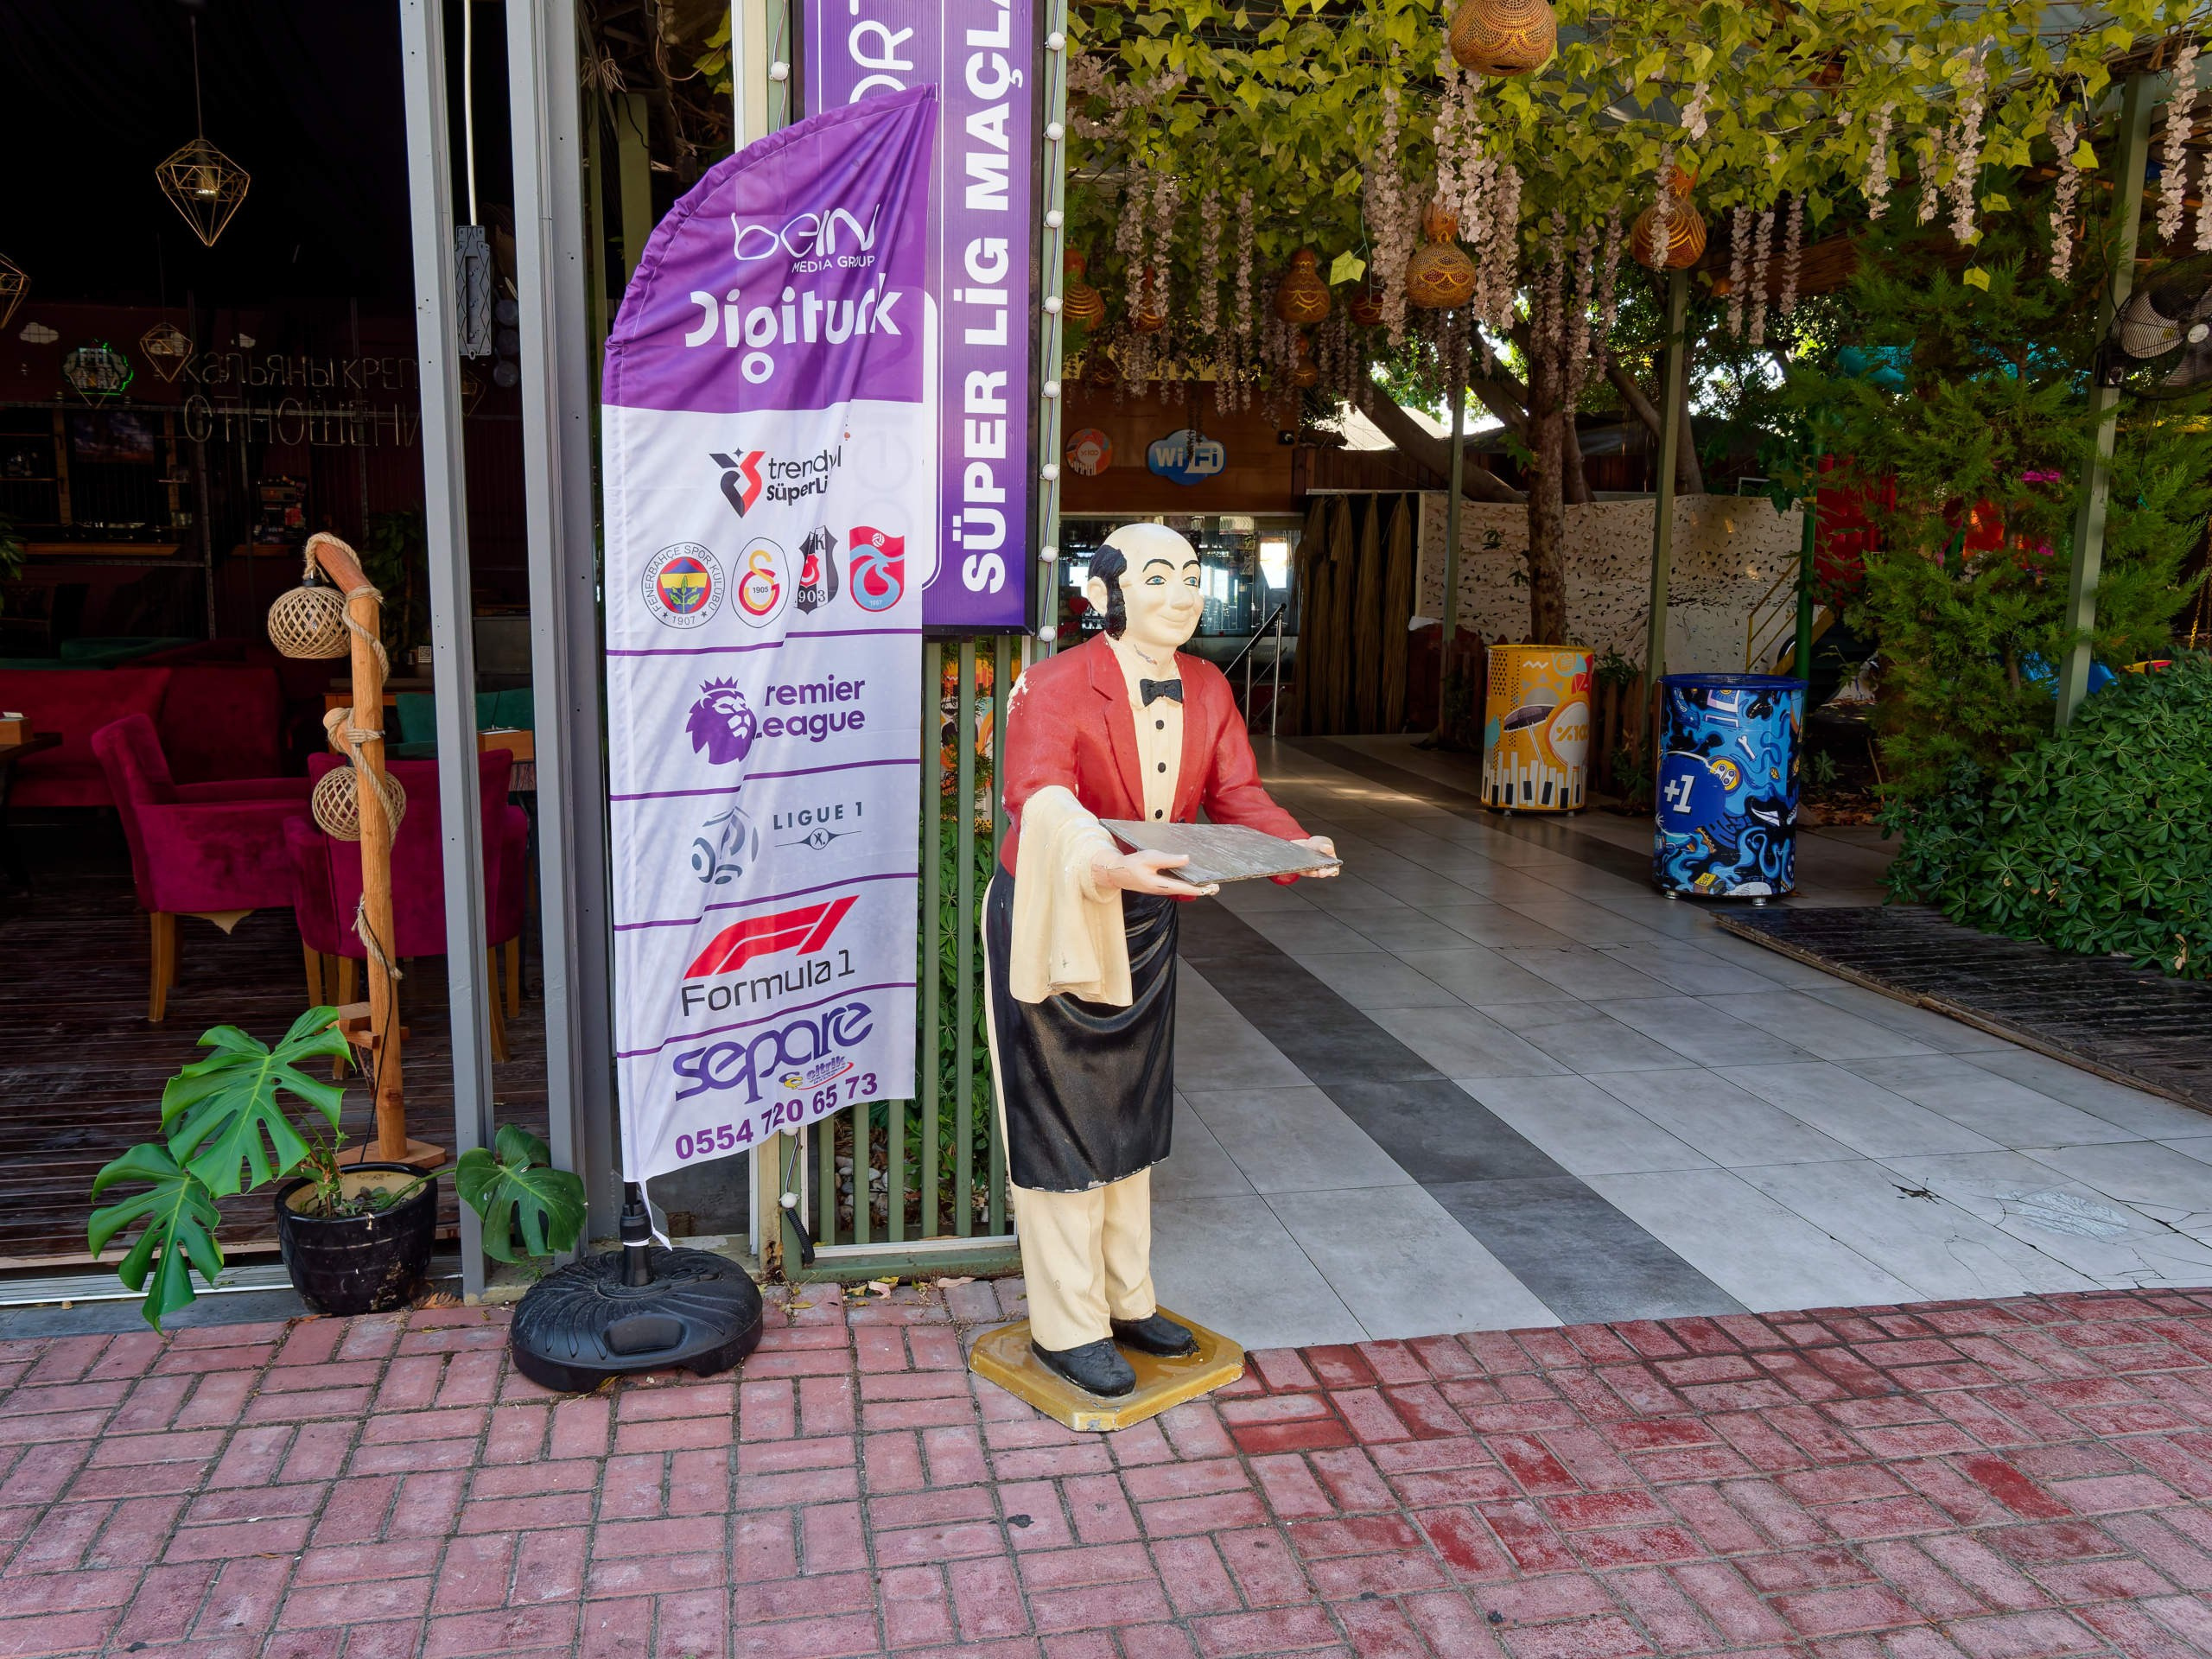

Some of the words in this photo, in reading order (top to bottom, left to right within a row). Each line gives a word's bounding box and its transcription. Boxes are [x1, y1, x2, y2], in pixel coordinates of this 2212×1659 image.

[964, 0, 1024, 211] MAÇL
[791, 258, 833, 273] MEDIA
[837, 255, 875, 268] GROUP
[685, 273, 902, 384] Digiturk
[766, 475, 828, 506] SüperLi
[952, 370, 1008, 594] SÜPER
[645, 546, 681, 612] FENERBAHÇE
[684, 545, 712, 565] SPOR
[752, 586, 769, 594] 1905
[796, 589, 825, 603] 903
[672, 615, 696, 626] 1907
[765, 674, 866, 707] remier
[1663, 774, 1695, 814] +1
[773, 804, 844, 830] LIGUE
[855, 801, 863, 817] 1
[681, 959, 831, 1017] Formula
[672, 1001, 874, 1104] separe
[675, 1117, 754, 1160] 0554
[762, 1097, 804, 1135] 720
[811, 1084, 838, 1116] 65
[844, 1072, 878, 1100] 73
